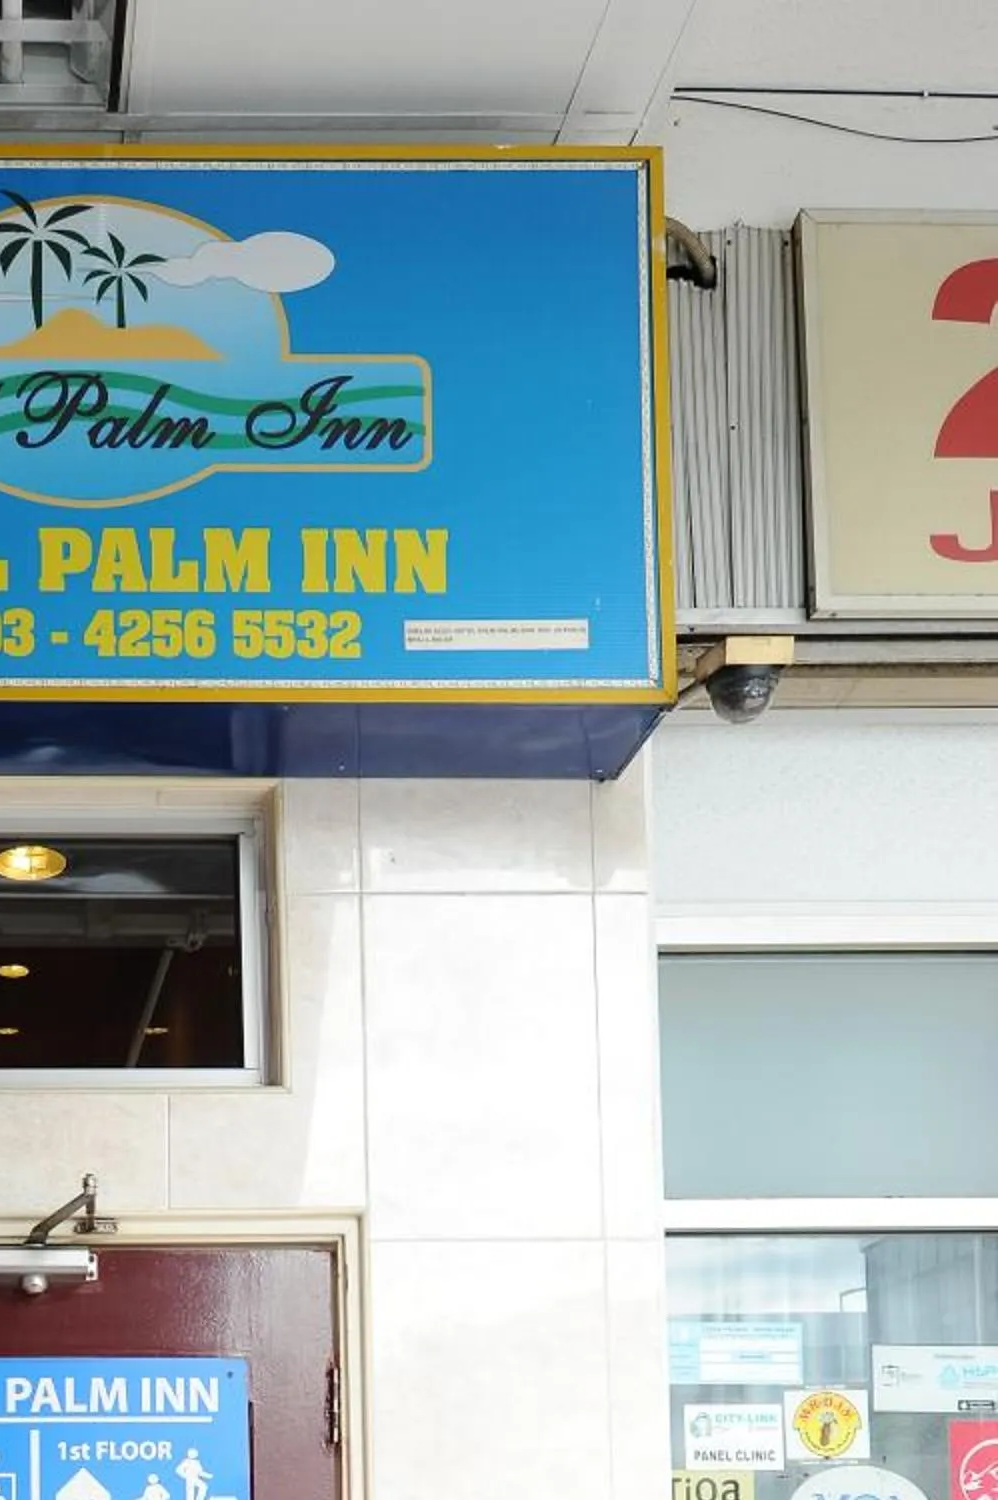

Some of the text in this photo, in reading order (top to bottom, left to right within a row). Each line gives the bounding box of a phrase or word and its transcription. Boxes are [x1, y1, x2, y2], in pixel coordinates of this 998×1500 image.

[15, 370, 215, 449] Palm
[246, 375, 413, 450] Inn
[38, 527, 272, 593] PALM
[301, 529, 449, 594] INN
[83, 608, 222, 658] 4256
[232, 609, 363, 659] 5532
[5, 1376, 129, 1414] PALM
[140, 1376, 219, 1413] INN
[57, 1440, 173, 1461] 1st FLOOR
[693, 1449, 778, 1462] PANEL CLINIC
